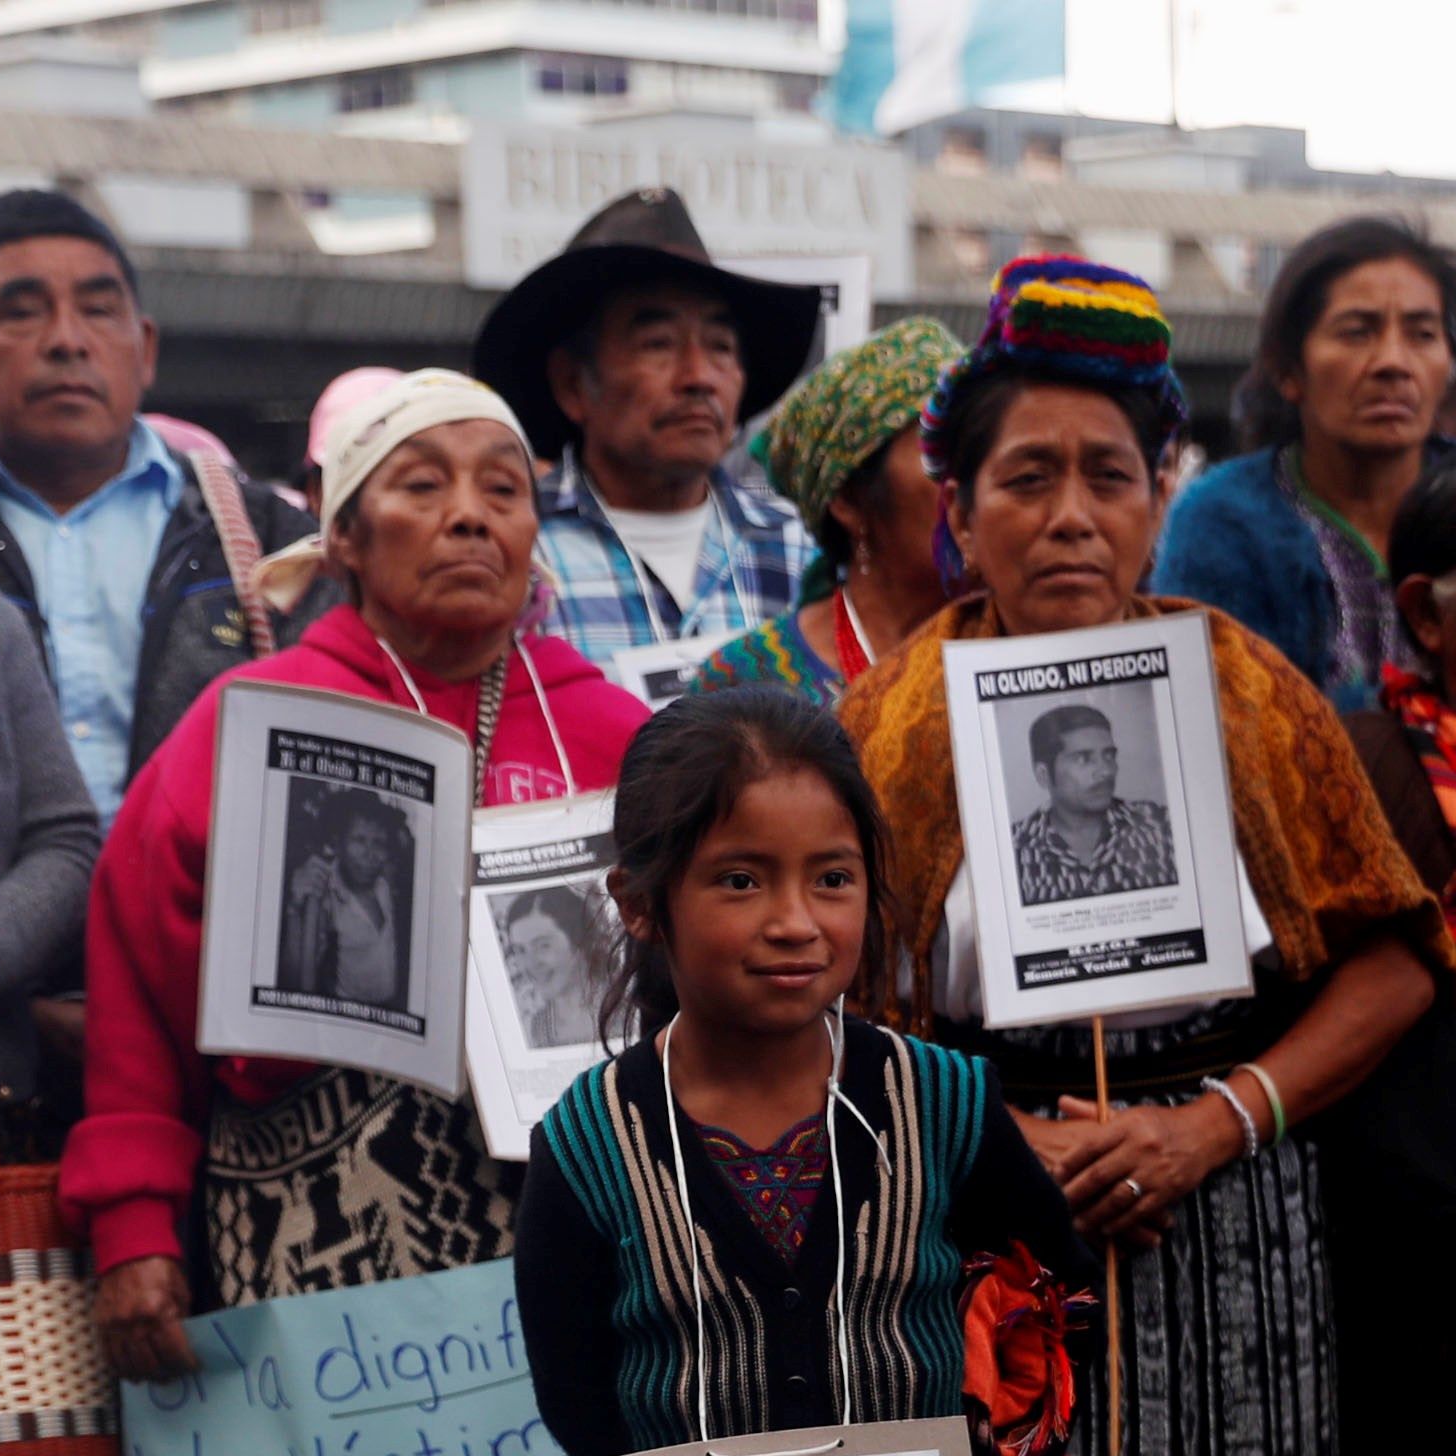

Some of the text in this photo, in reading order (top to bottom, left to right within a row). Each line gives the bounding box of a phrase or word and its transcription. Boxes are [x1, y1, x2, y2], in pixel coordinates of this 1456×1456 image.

[979, 650, 1166, 697] NI OLVIDO, NI PERDON
[280, 749, 294, 769] Ni
[316, 756, 355, 779] Olvido
[1083, 958, 1130, 975] Verdad
[1141, 949, 1196, 966] Justicia
